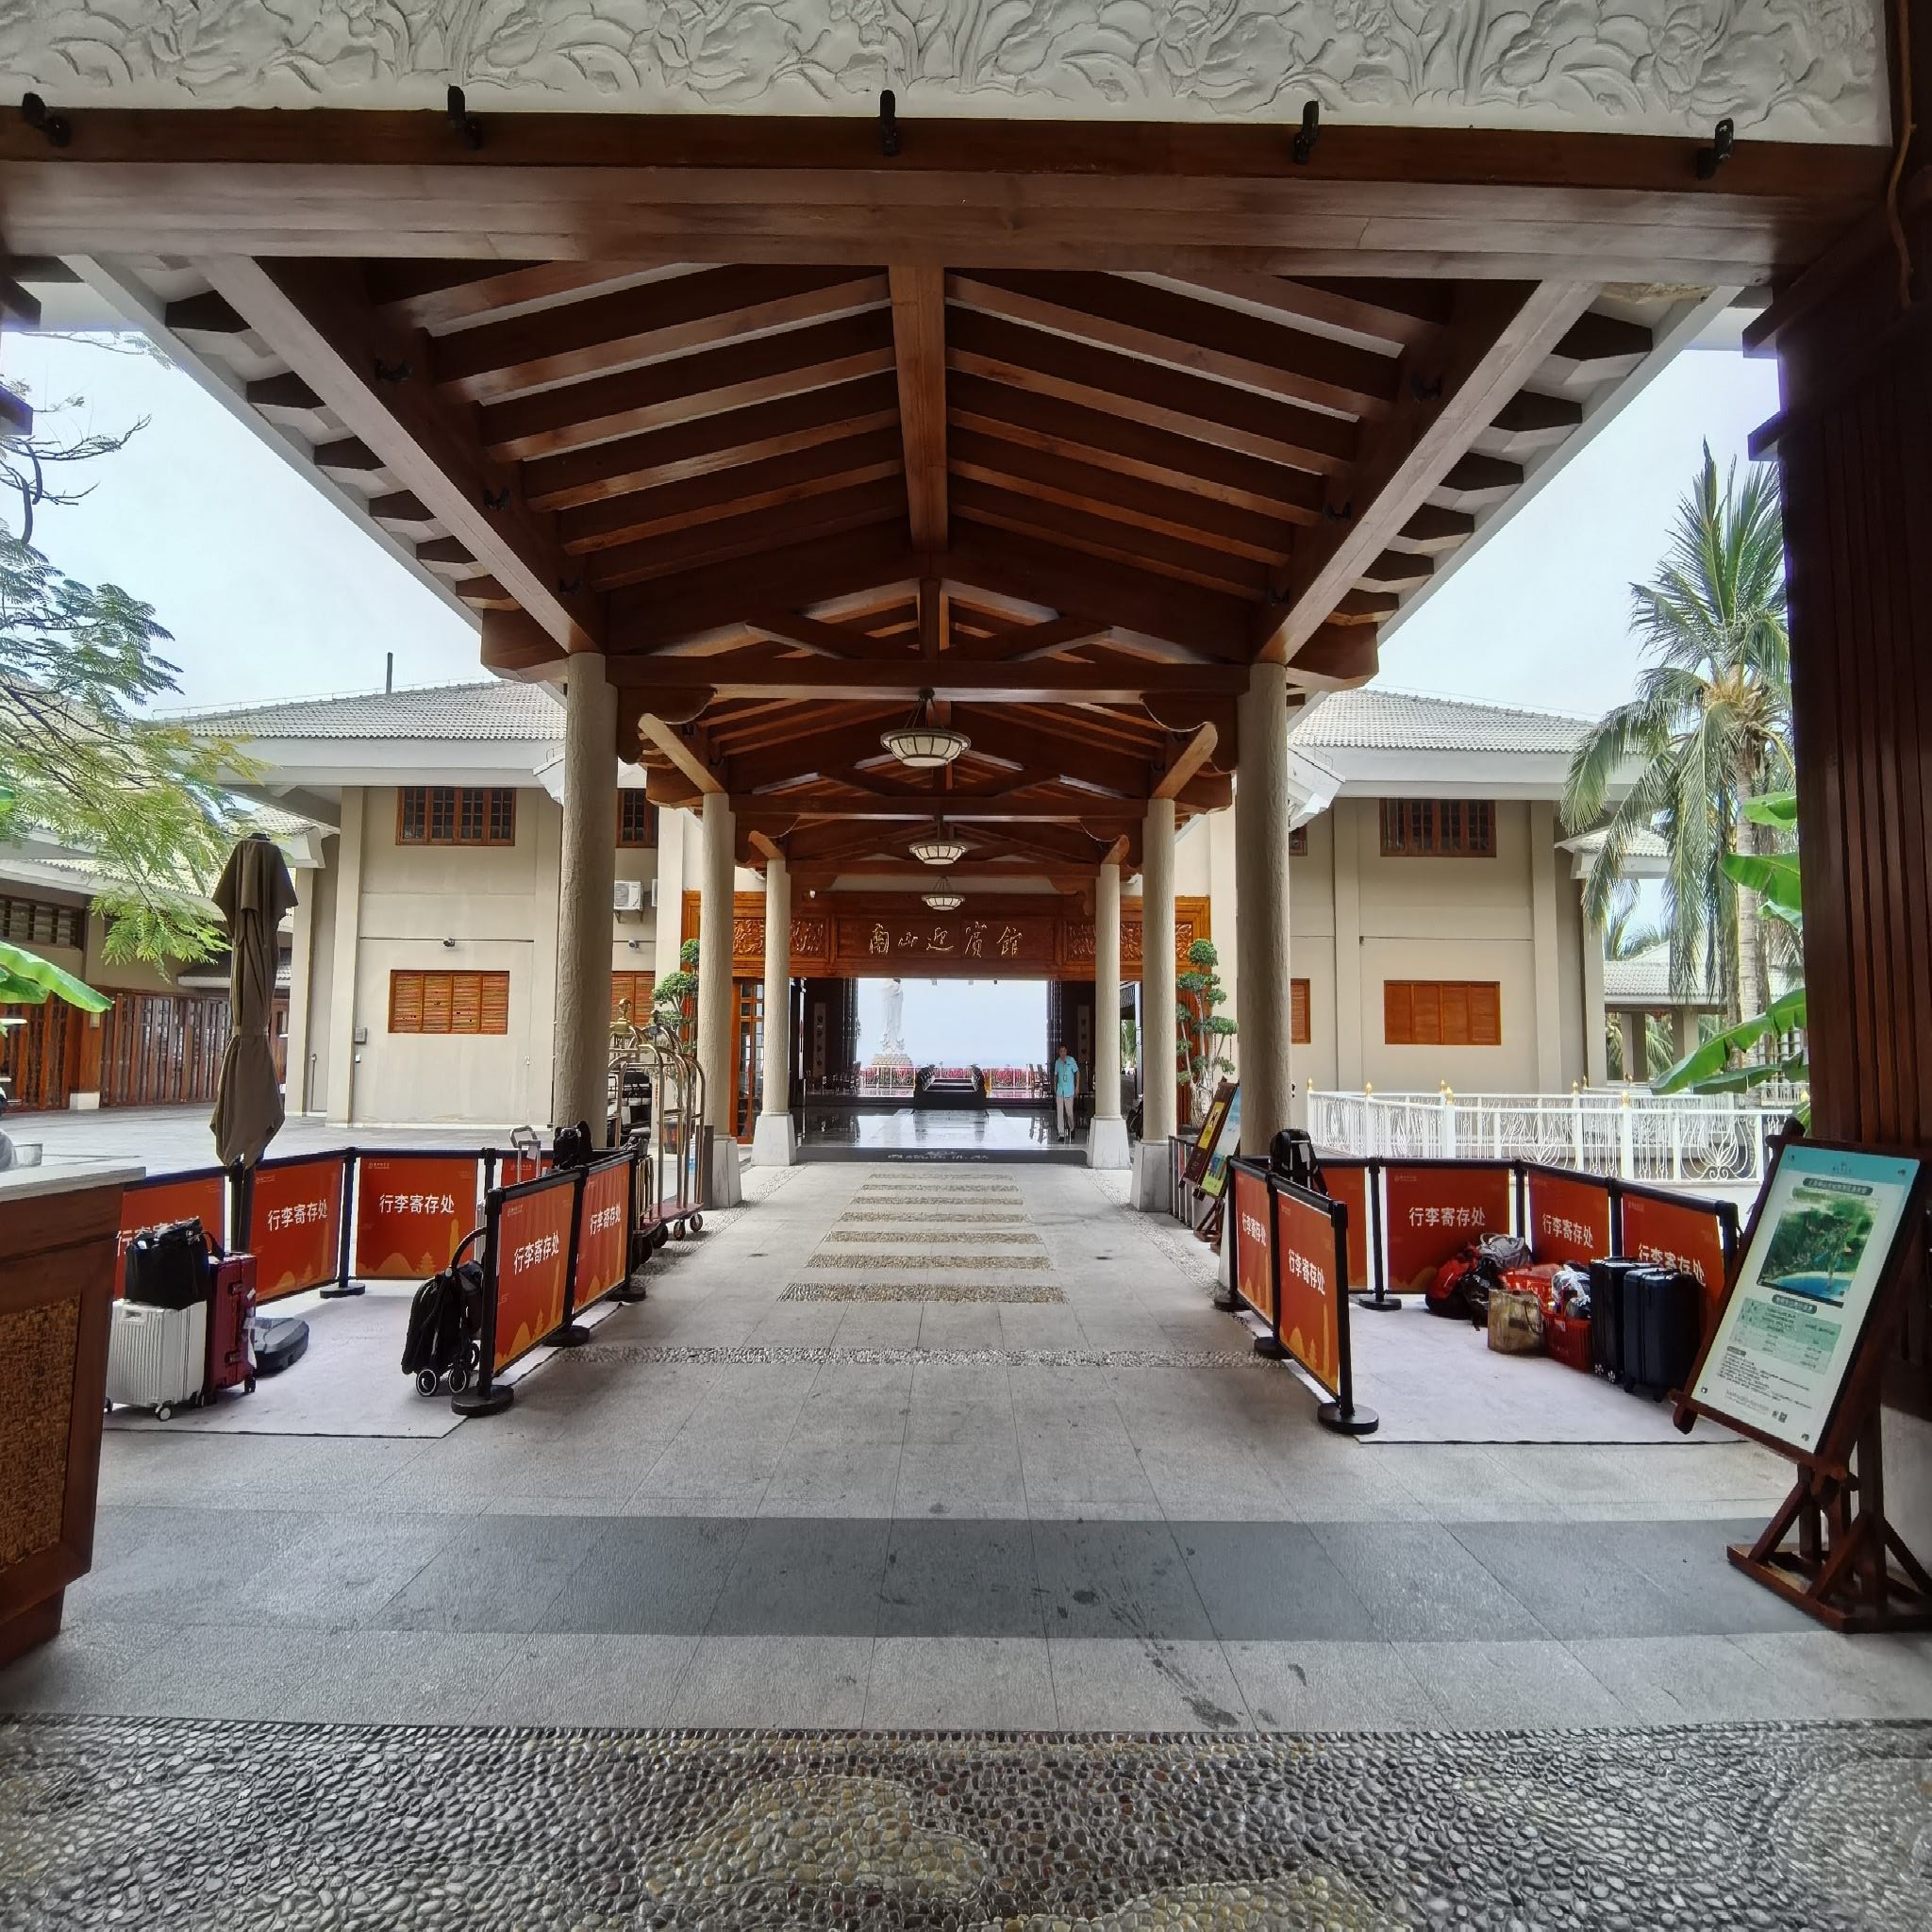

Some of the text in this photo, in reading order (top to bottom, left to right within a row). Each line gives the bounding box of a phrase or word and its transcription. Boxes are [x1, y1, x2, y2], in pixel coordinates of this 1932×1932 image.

[268, 1199, 328, 1232] 行李寄存处
[379, 1194, 455, 1214] 行李寄存处
[590, 1202, 622, 1237] 行李寄存处
[1408, 1207, 1486, 1227] 行李寄存处
[1241, 1211, 1267, 1247] 行李寄存处
[1542, 1213, 1594, 1249] 行李寄存处
[513, 1230, 559, 1274] 行李寄存处
[1289, 1248, 1326, 1295] 行李寄存处
